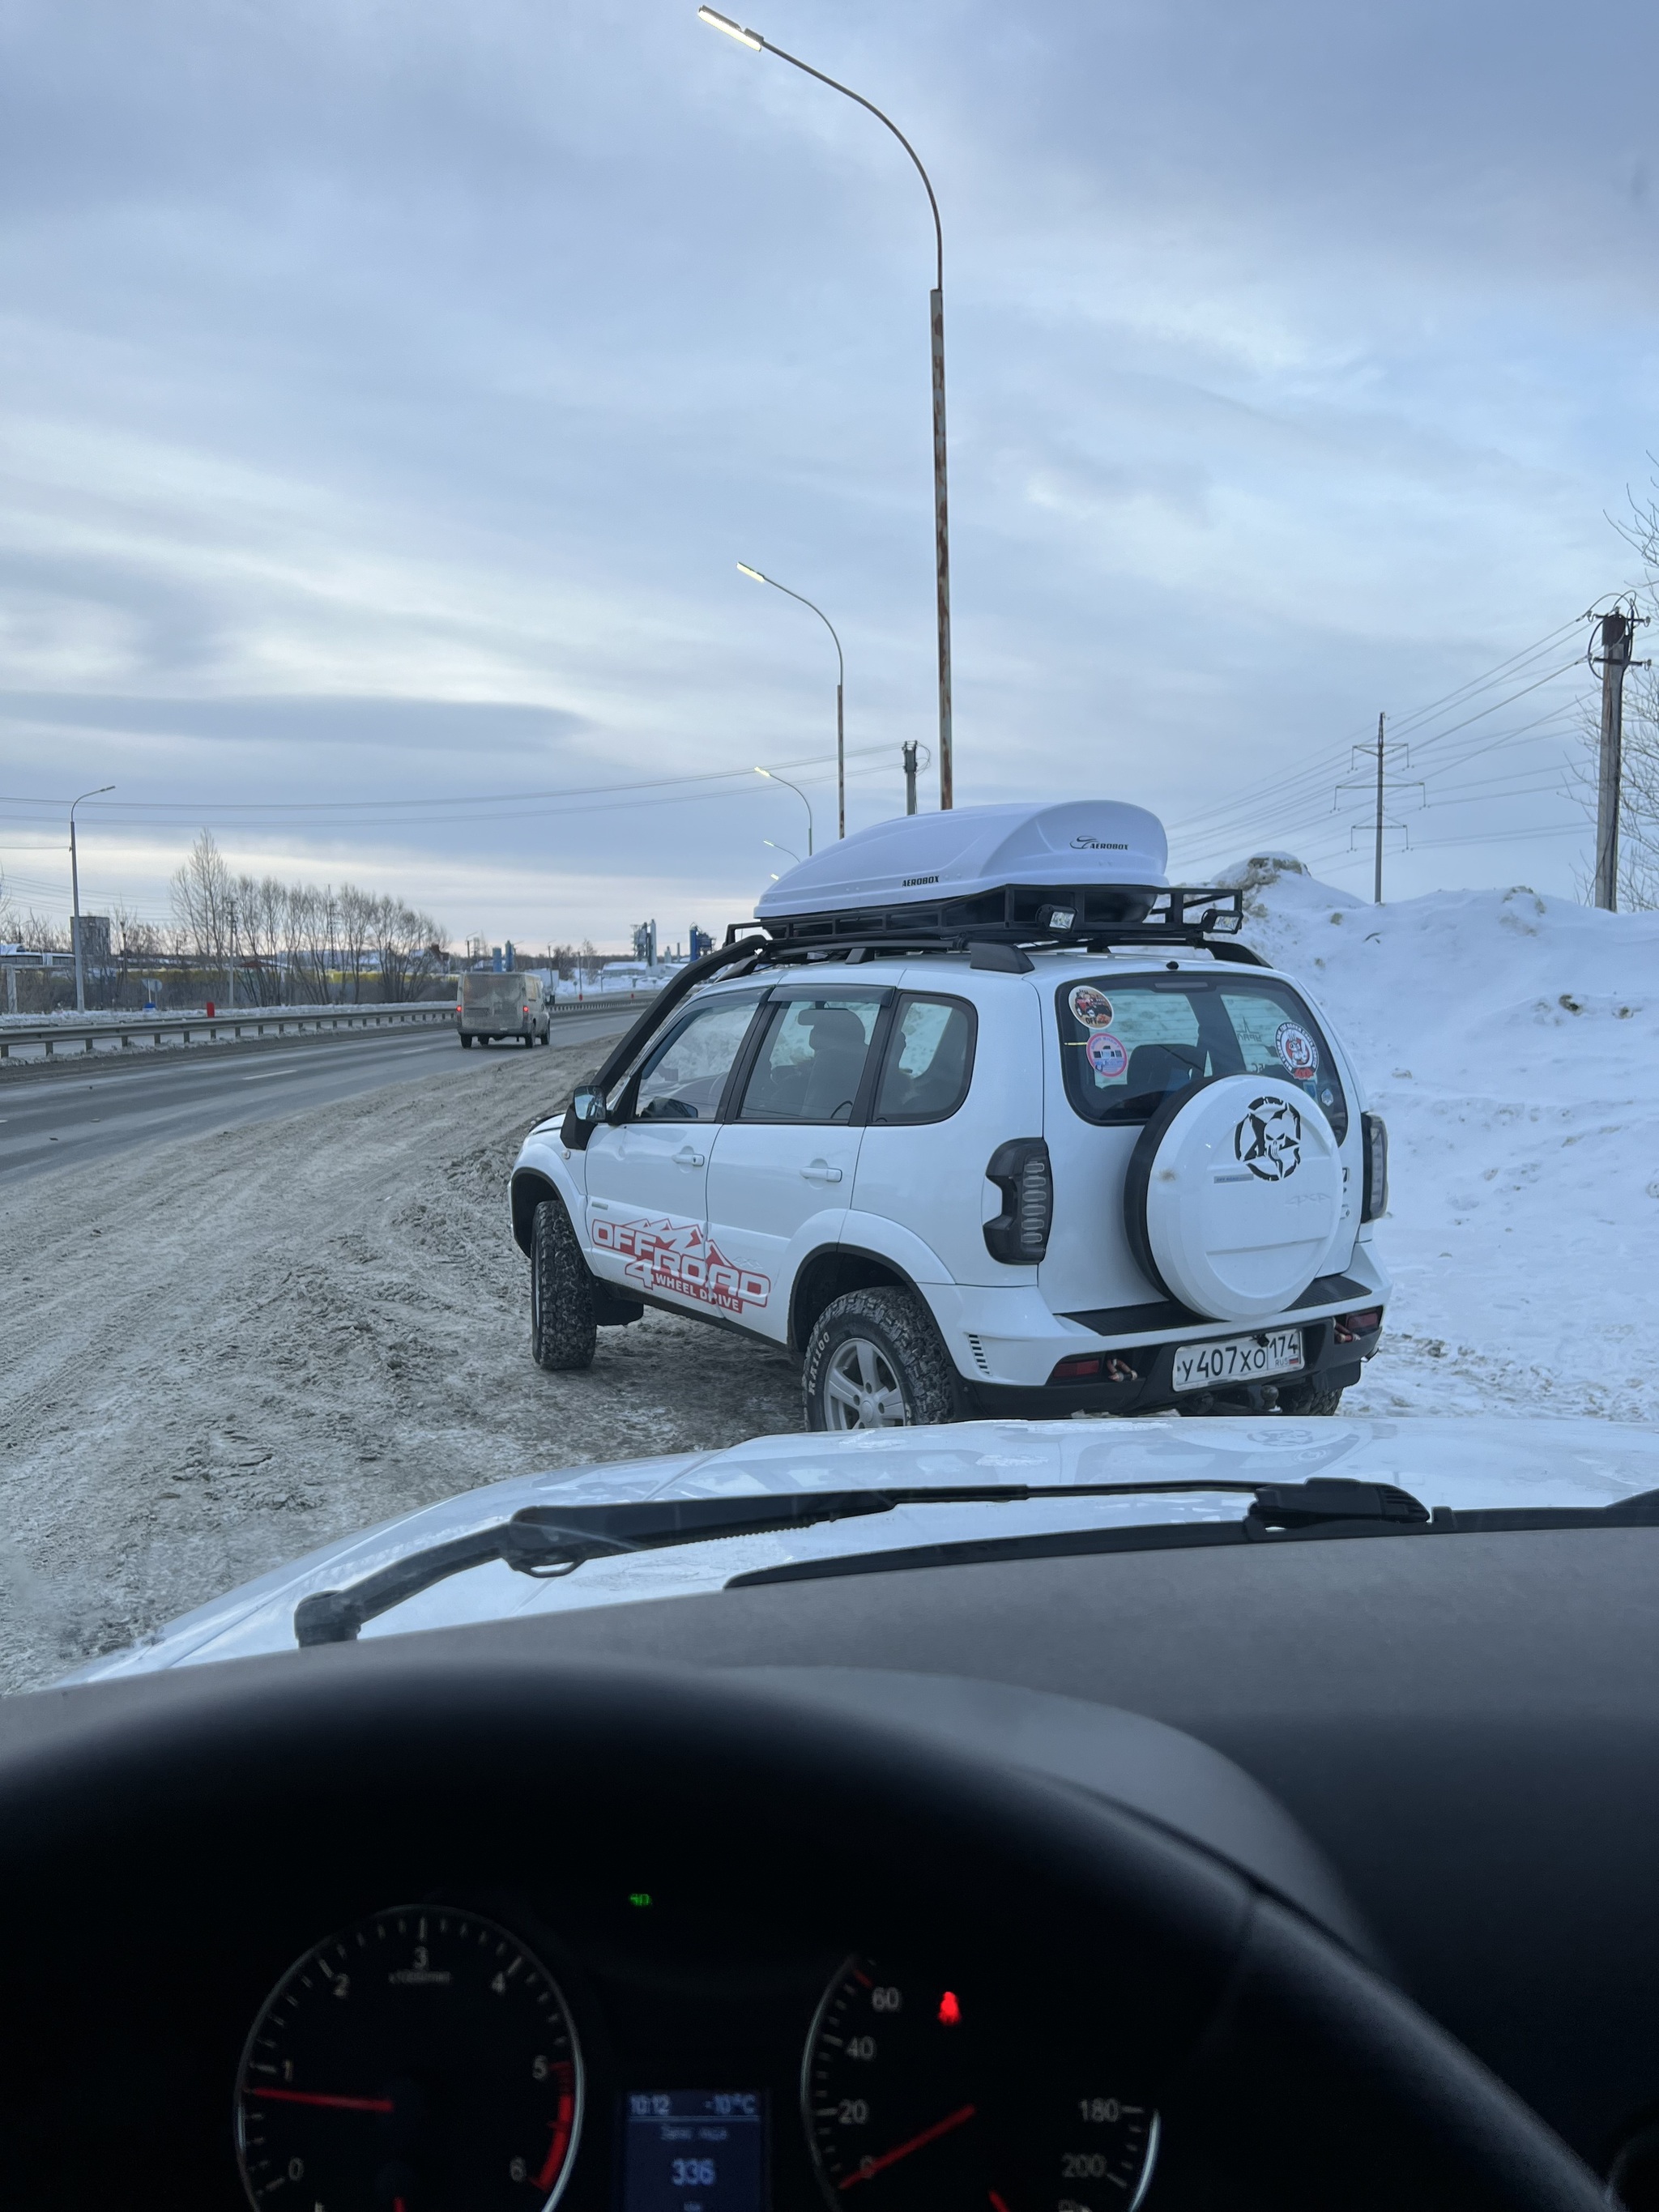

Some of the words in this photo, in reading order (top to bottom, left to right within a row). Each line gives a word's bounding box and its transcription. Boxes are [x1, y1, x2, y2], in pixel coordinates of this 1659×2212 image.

[1089, 842, 1129, 850] AEROBOX
[902, 875, 940, 888] AEROBOX
[655, 1272, 702, 1300] WHEEL
[699, 1289, 740, 1311] DRIVE
[1269, 1333, 1299, 1358] 174
[1274, 1358, 1289, 1367] RUS
[412, 1946, 430, 1970] 3
[331, 1973, 351, 1998] 2
[490, 1973, 507, 1996] 4
[872, 1987, 901, 2012] 60
[846, 2035, 876, 2061] 40
[282, 2058, 294, 2082] 1
[531, 2056, 549, 2081] 5
[838, 2099, 868, 2124] 20
[1078, 2098, 1120, 2123] 180
[287, 2157, 305, 2182] 0
[509, 2155, 527, 2183] 6
[1060, 2153, 1107, 2178] 200
